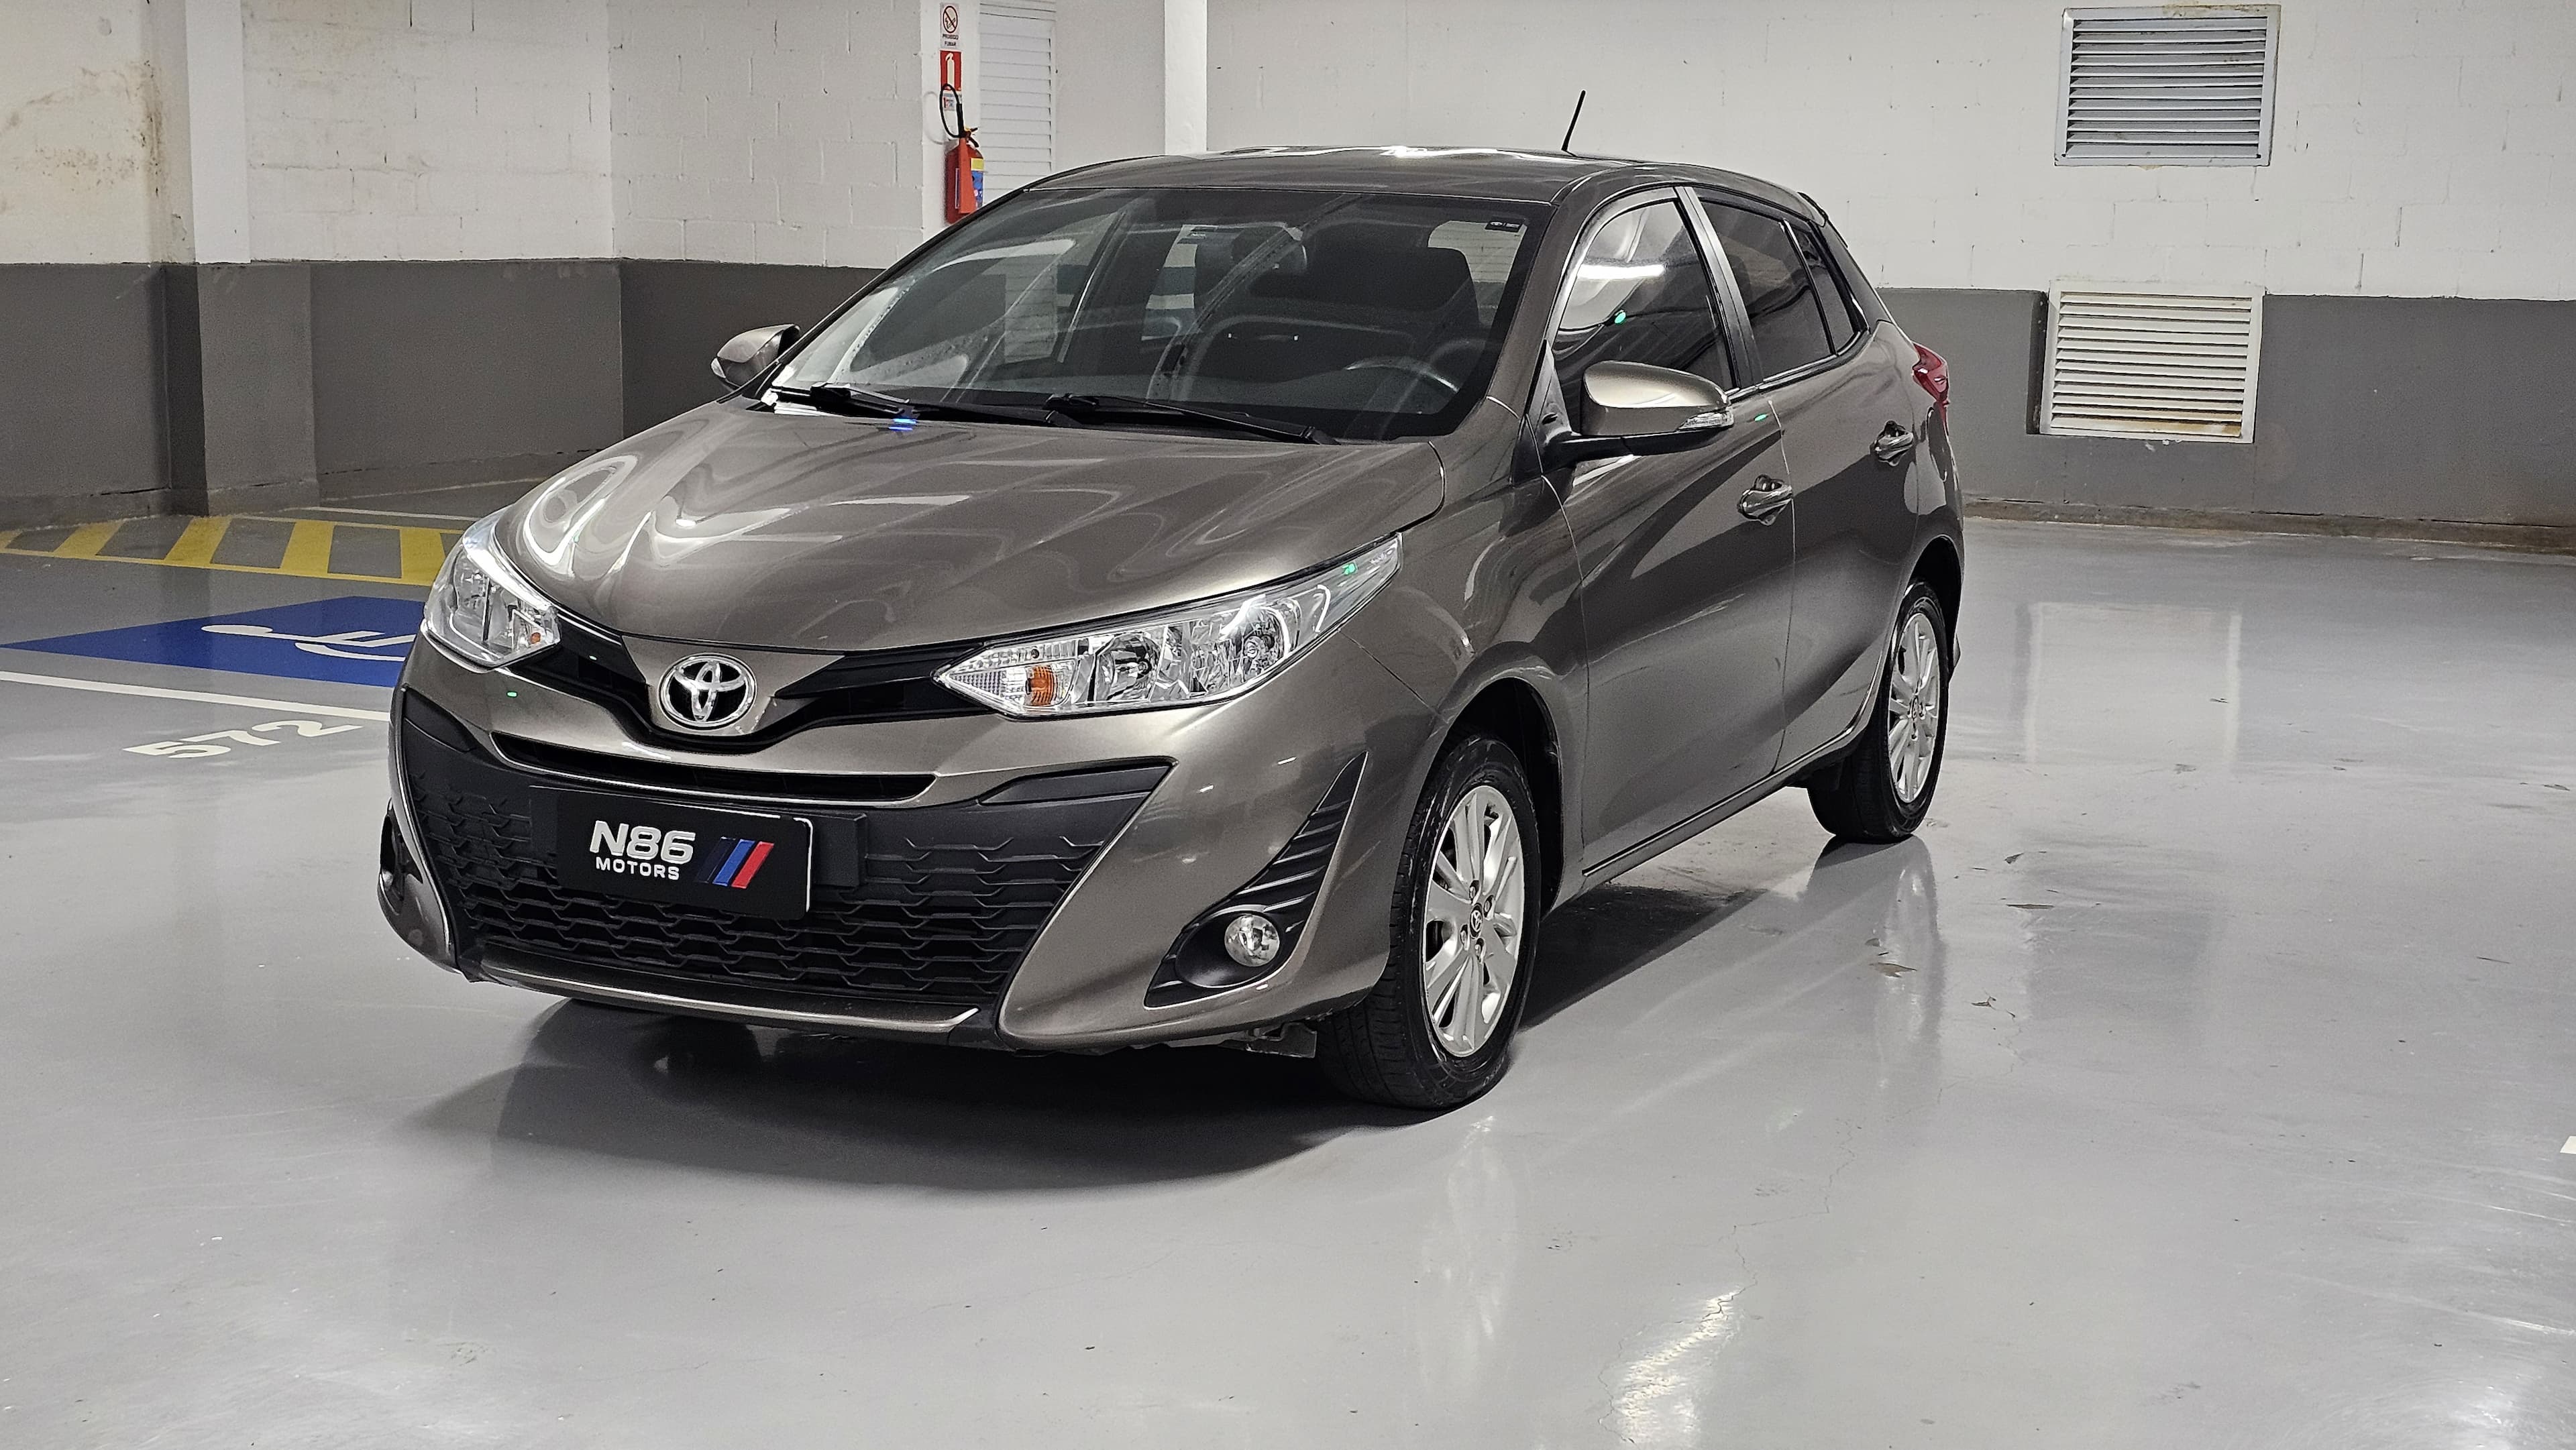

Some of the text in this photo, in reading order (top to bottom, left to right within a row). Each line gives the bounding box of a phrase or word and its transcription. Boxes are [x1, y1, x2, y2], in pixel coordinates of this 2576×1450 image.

[123, 720, 363, 758] 572
[590, 820, 696, 864] N86
[596, 856, 680, 880] MOTORS
